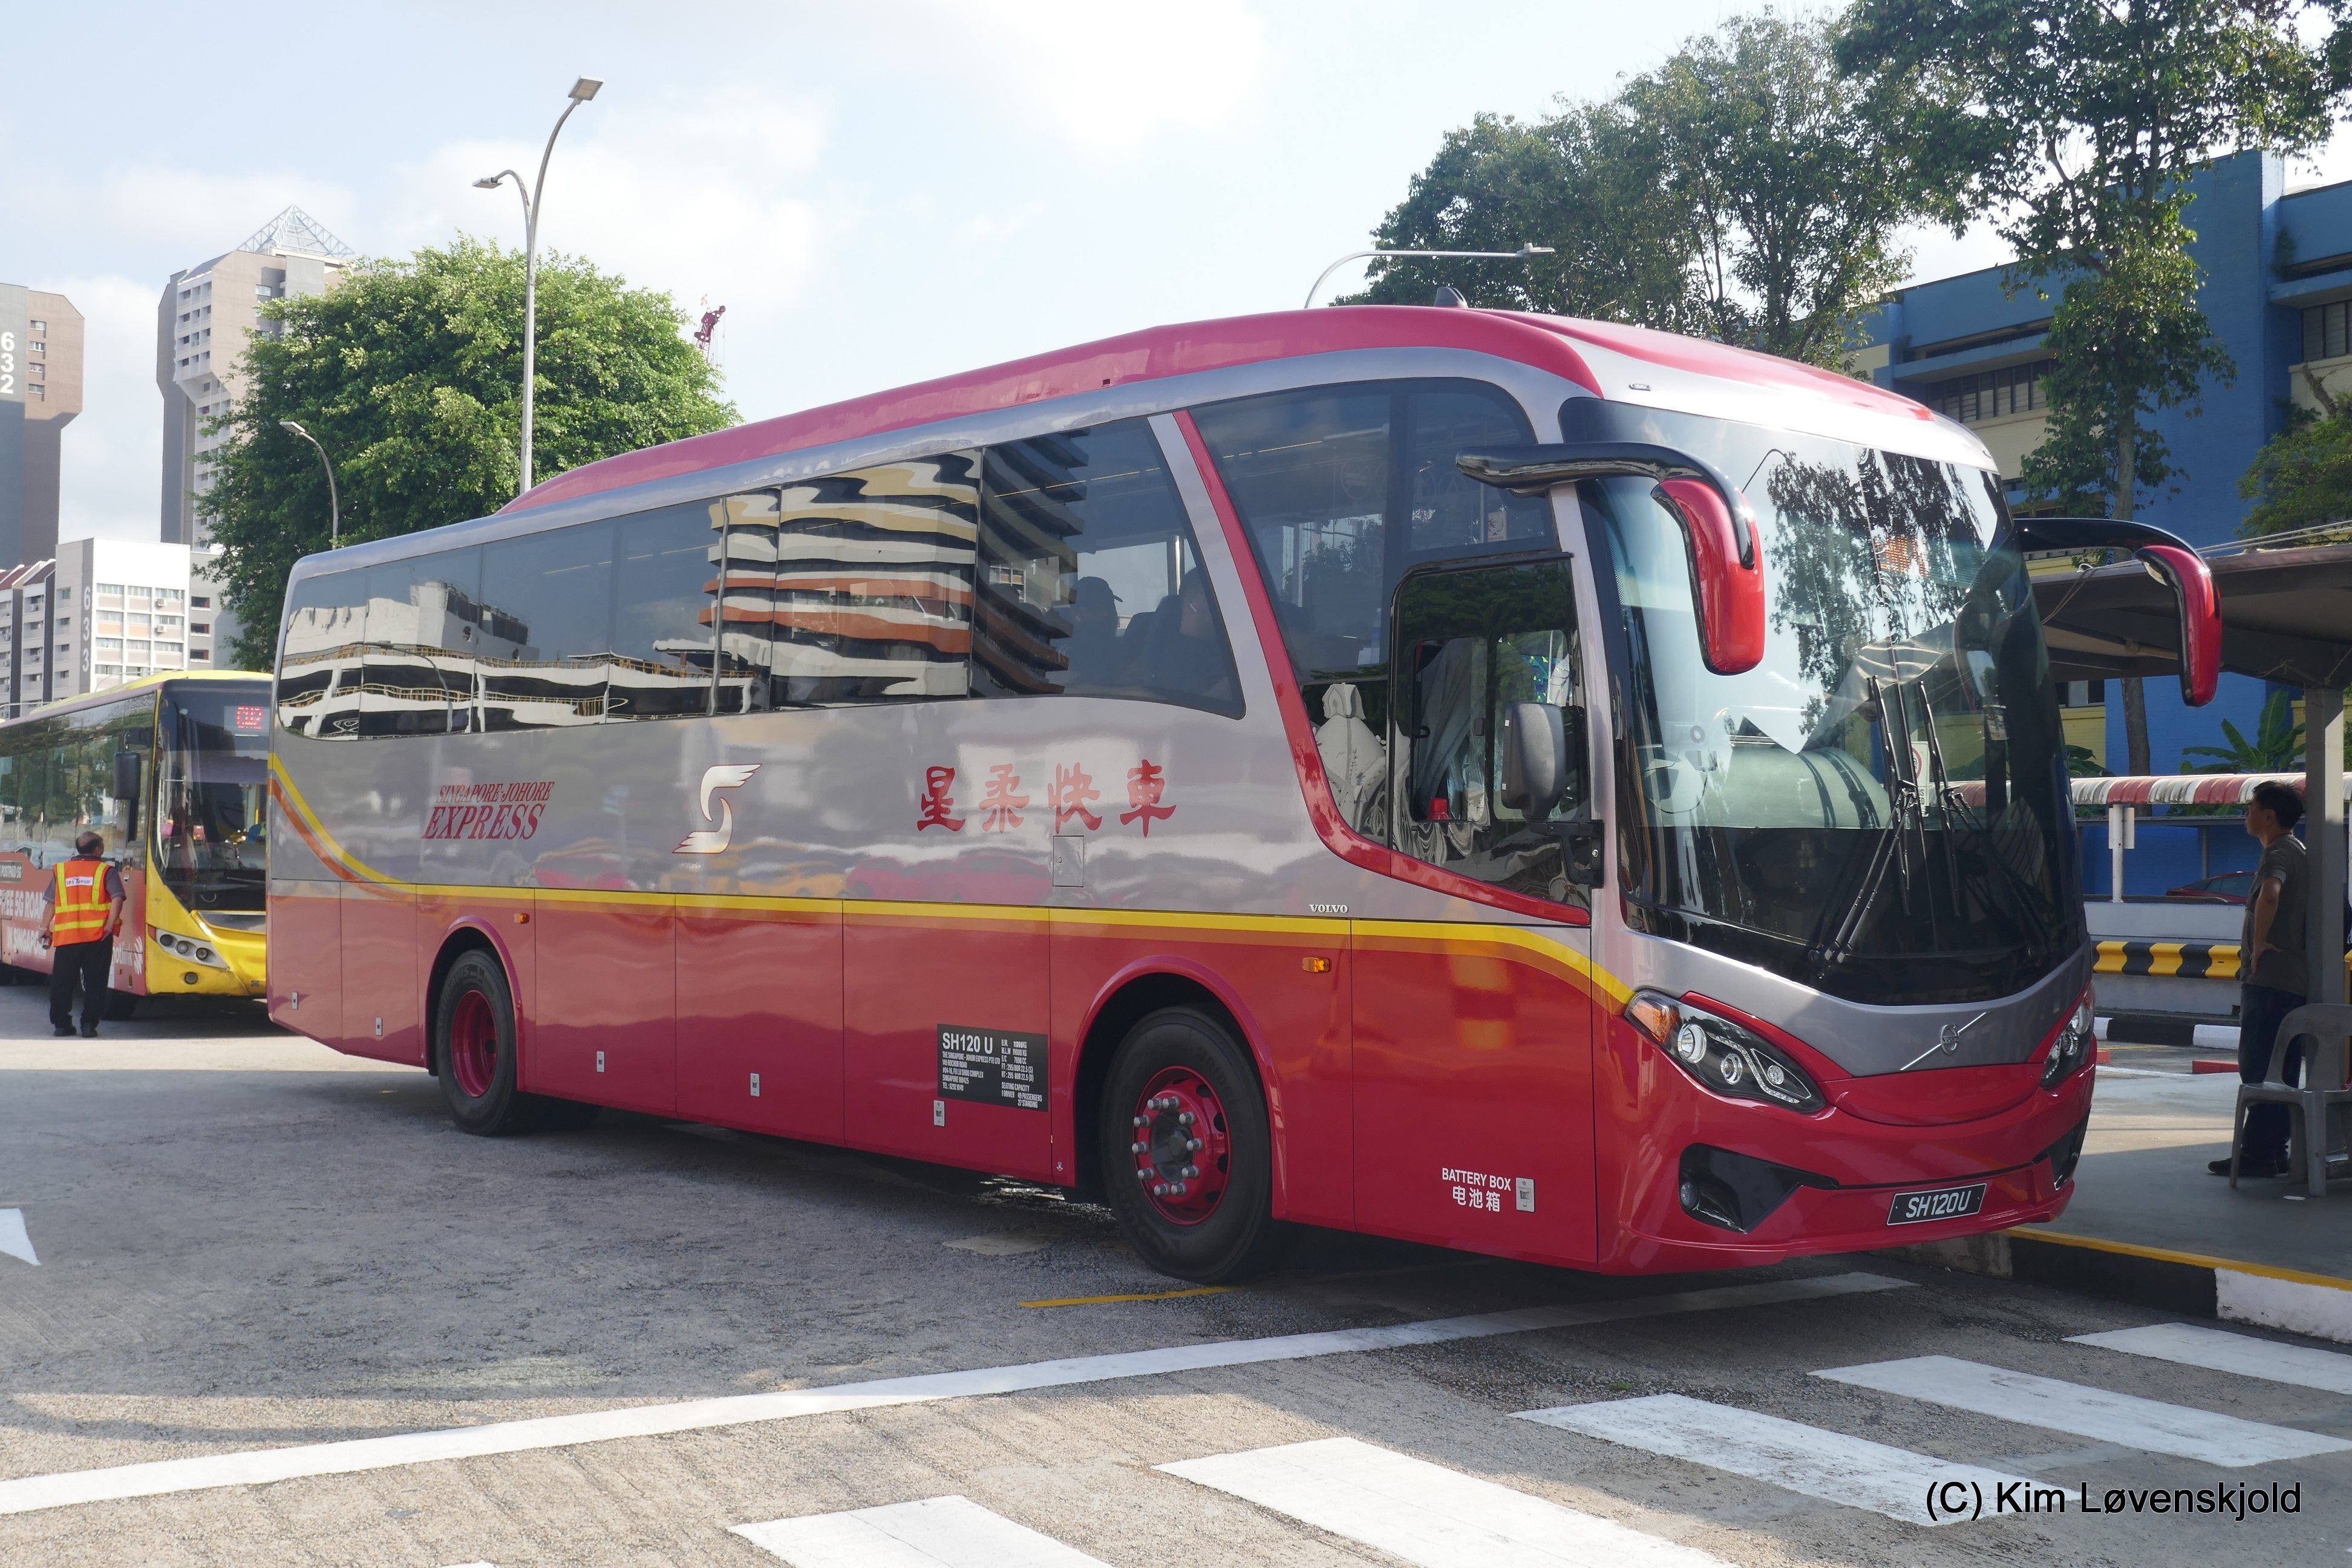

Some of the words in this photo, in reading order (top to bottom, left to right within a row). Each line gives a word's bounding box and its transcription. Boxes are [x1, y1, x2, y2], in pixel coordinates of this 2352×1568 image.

[0, 332, 15, 394] 632
[82, 586, 91, 672] 633
[436, 782, 555, 804] SINGAPORE-JOHORE
[916, 759, 1177, 838] 星柔快車
[421, 803, 546, 840] EXPRESS
[15, 890, 24, 918] 5G
[1308, 904, 1348, 913] VOLVO
[942, 1032, 981, 1053] SH120
[984, 1036, 993, 1054] U
[948, 1051, 964, 1060] SINGAPORE
[975, 1055, 988, 1063] EXPRESS
[942, 1074, 958, 1083] SINGAPORE
[970, 1070, 984, 1078] COMPLEX
[1002, 1082, 1014, 1090] SEATING
[1014, 1083, 1030, 1093] CAPACITY
[1022, 1093, 1042, 1102] PASSENGERS
[1022, 1100, 1038, 1108] STANDING
[1442, 1168, 1487, 1187] BATTERY
[1489, 1175, 1511, 1191] BOX
[1452, 1186, 1500, 1212] 电池箱
[1906, 1191, 1971, 1218] SH120U
